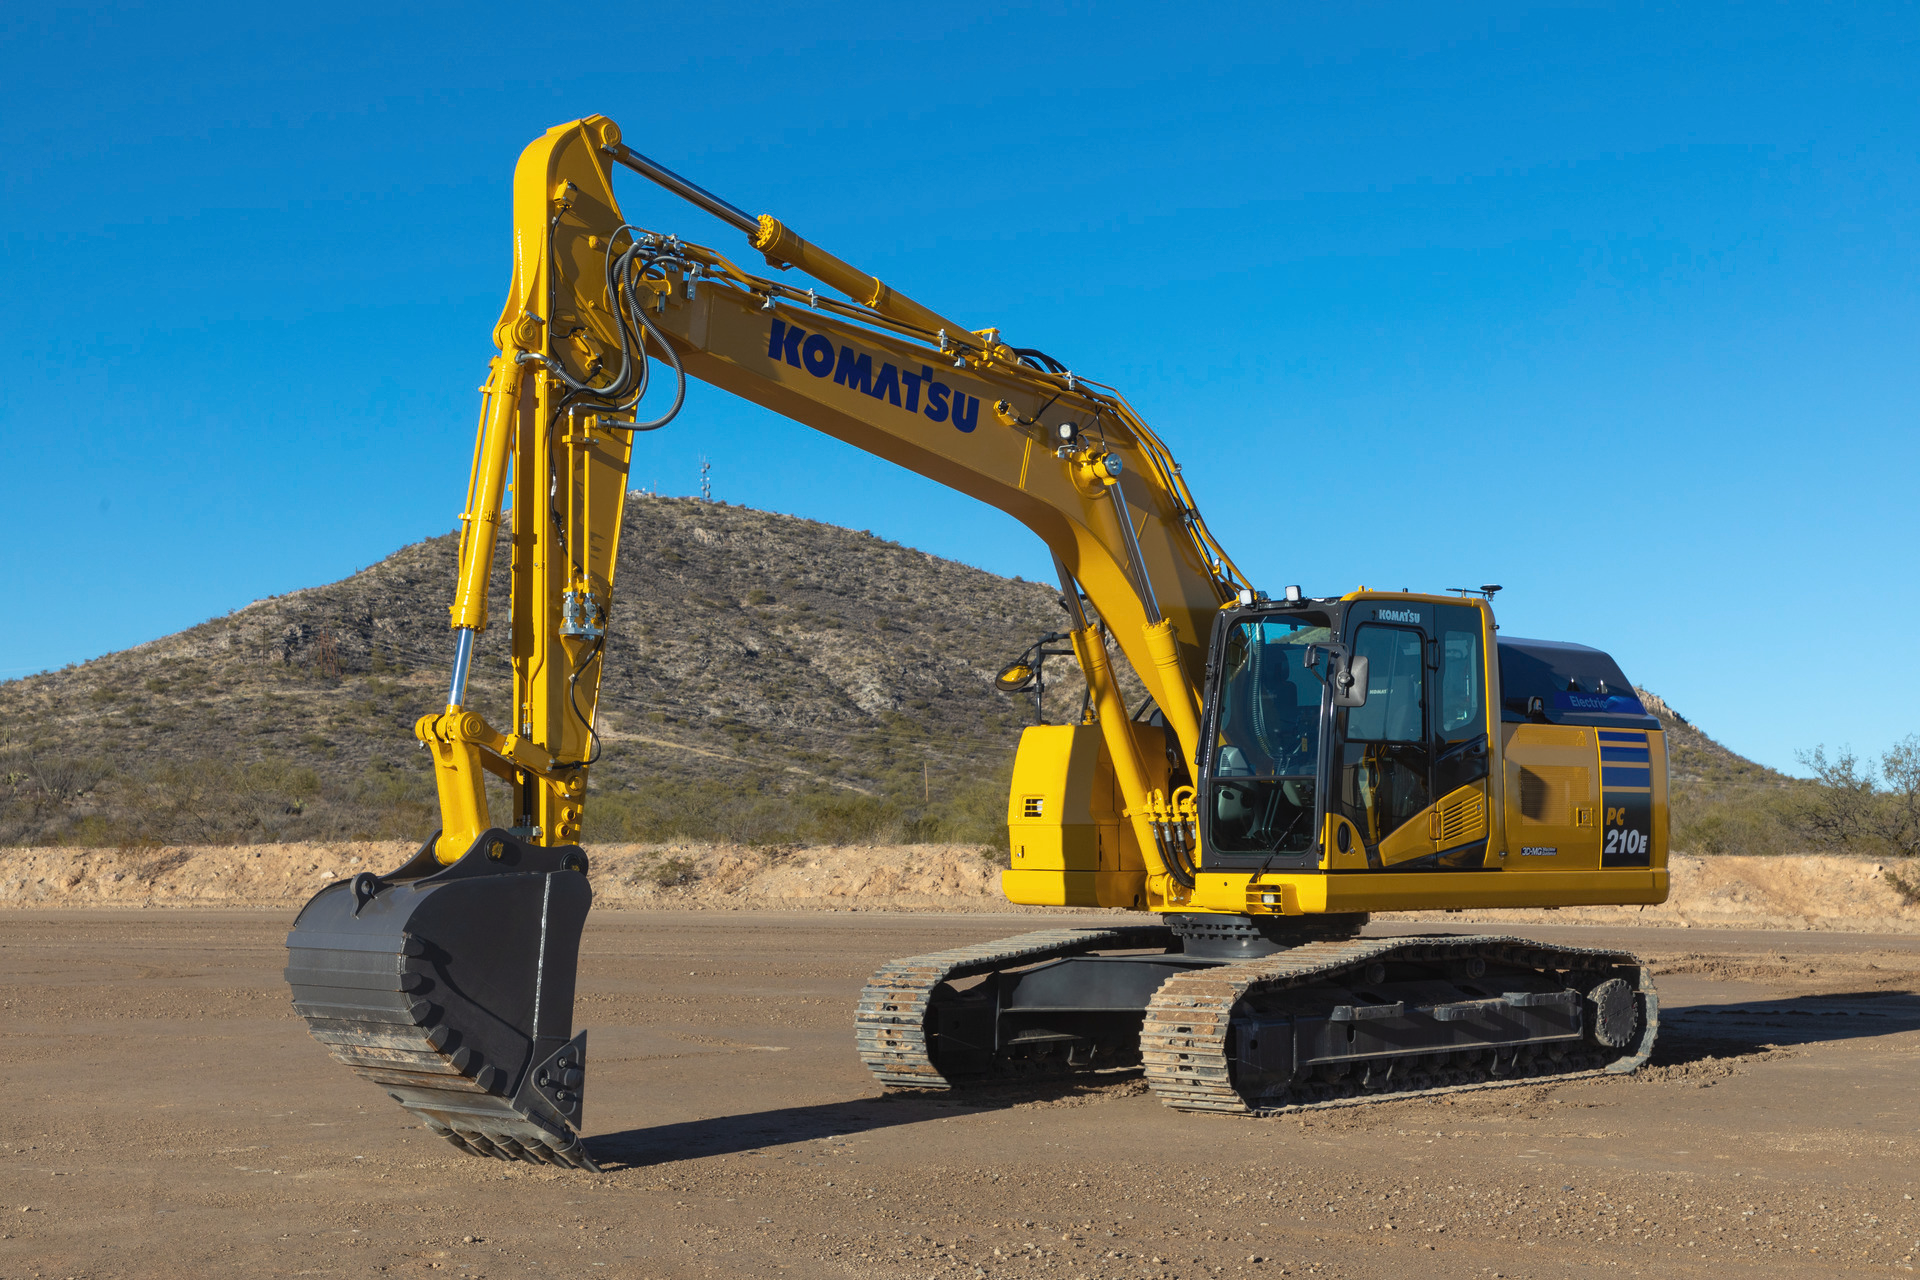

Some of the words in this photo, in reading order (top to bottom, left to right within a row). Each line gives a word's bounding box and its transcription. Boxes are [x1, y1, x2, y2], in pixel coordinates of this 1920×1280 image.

[768, 318, 980, 433] KOMATSU
[1379, 609, 1420, 623] KOMATSU
[1569, 695, 1608, 709] Electric
[1606, 807, 1625, 826] PC
[1604, 829, 1648, 854] 210E
